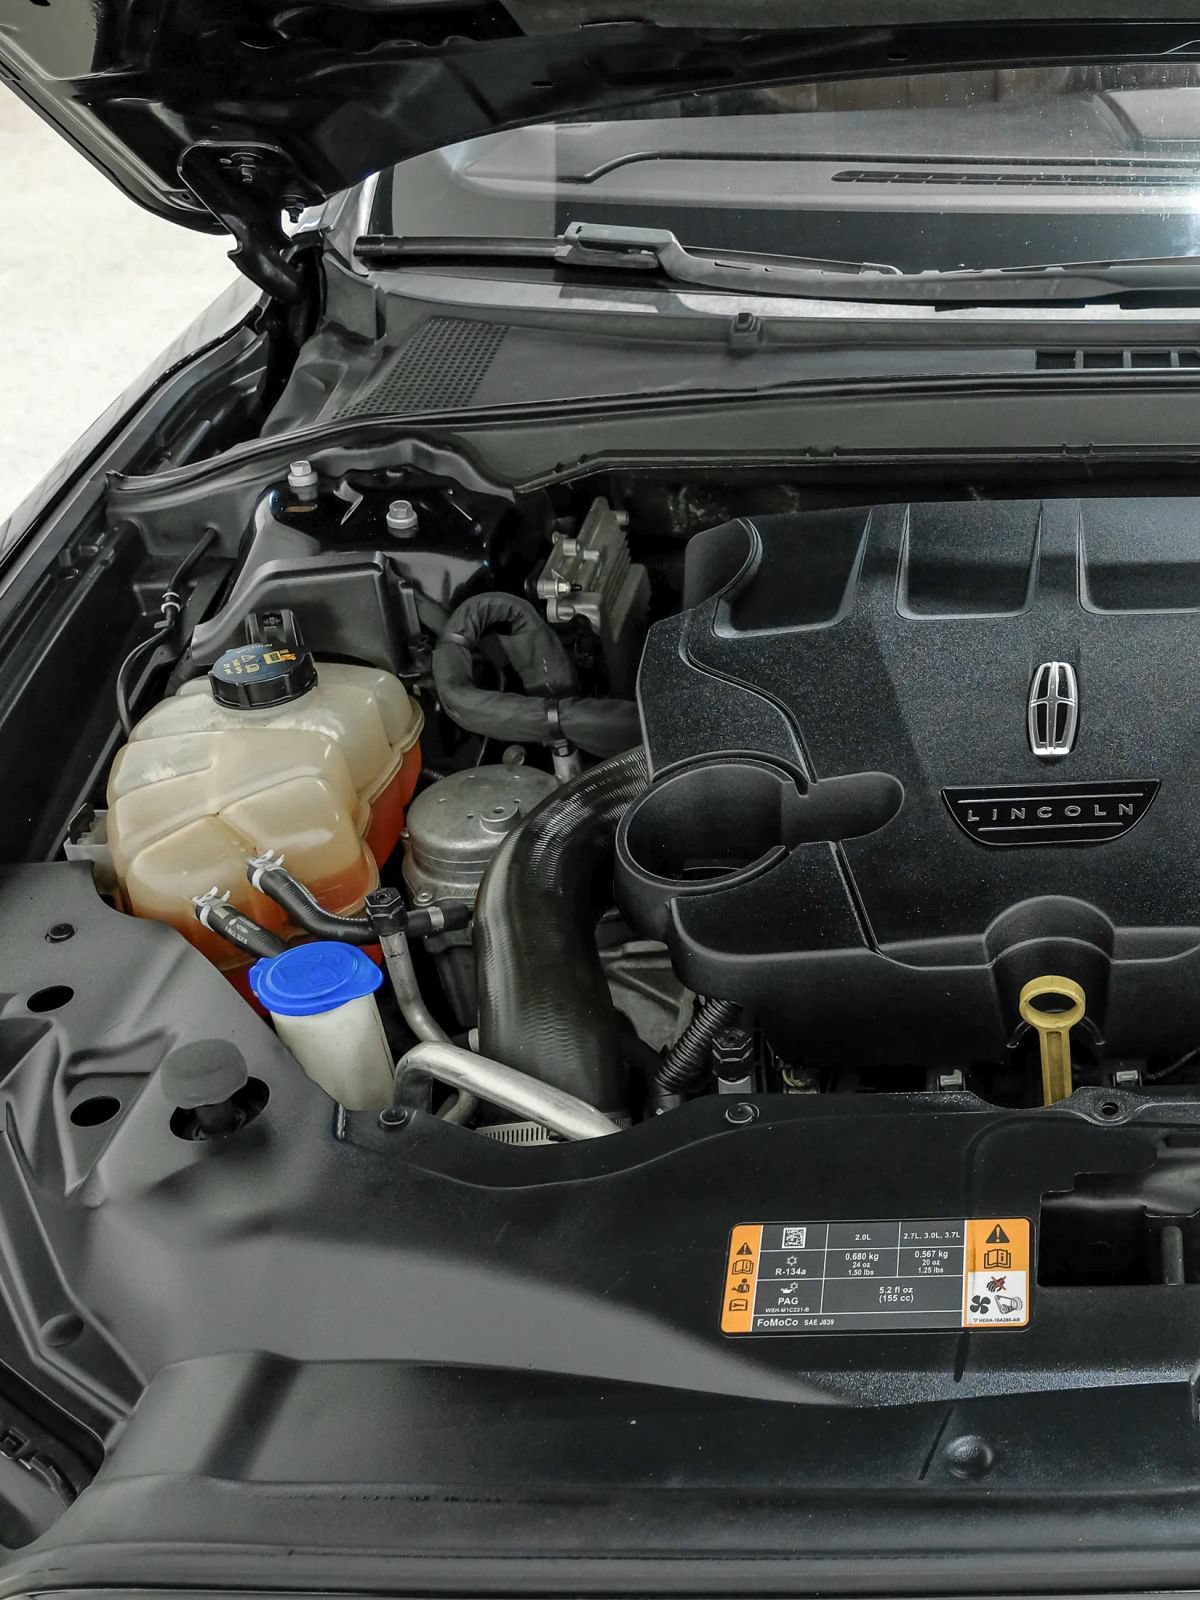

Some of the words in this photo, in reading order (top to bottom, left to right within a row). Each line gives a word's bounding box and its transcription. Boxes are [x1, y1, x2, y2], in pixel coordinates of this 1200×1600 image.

[967, 803, 1134, 822] LINCOLN
[855, 1233, 872, 1241] 2.0L
[903, 1232, 922, 1240] 2.7L,
[924, 1231, 943, 1239] 3.0L,
[845, 1252, 867, 1261] 0.680
[868, 1252, 879, 1262] kg
[914, 1250, 936, 1258] 0.567
[938, 1249, 949, 1260] kg
[775, 1267, 807, 1276] R-134a
[879, 1286, 892, 1294] 5.2
[894, 1286, 900, 1294] fl
[777, 1297, 799, 1306] PAG
[879, 1294, 898, 1303] (155
[900, 1294, 914, 1303] cc)
[757, 1317, 799, 1327] FoMoCo
[804, 1318, 818, 1326] SAE
[819, 1318, 835, 1326] J639
